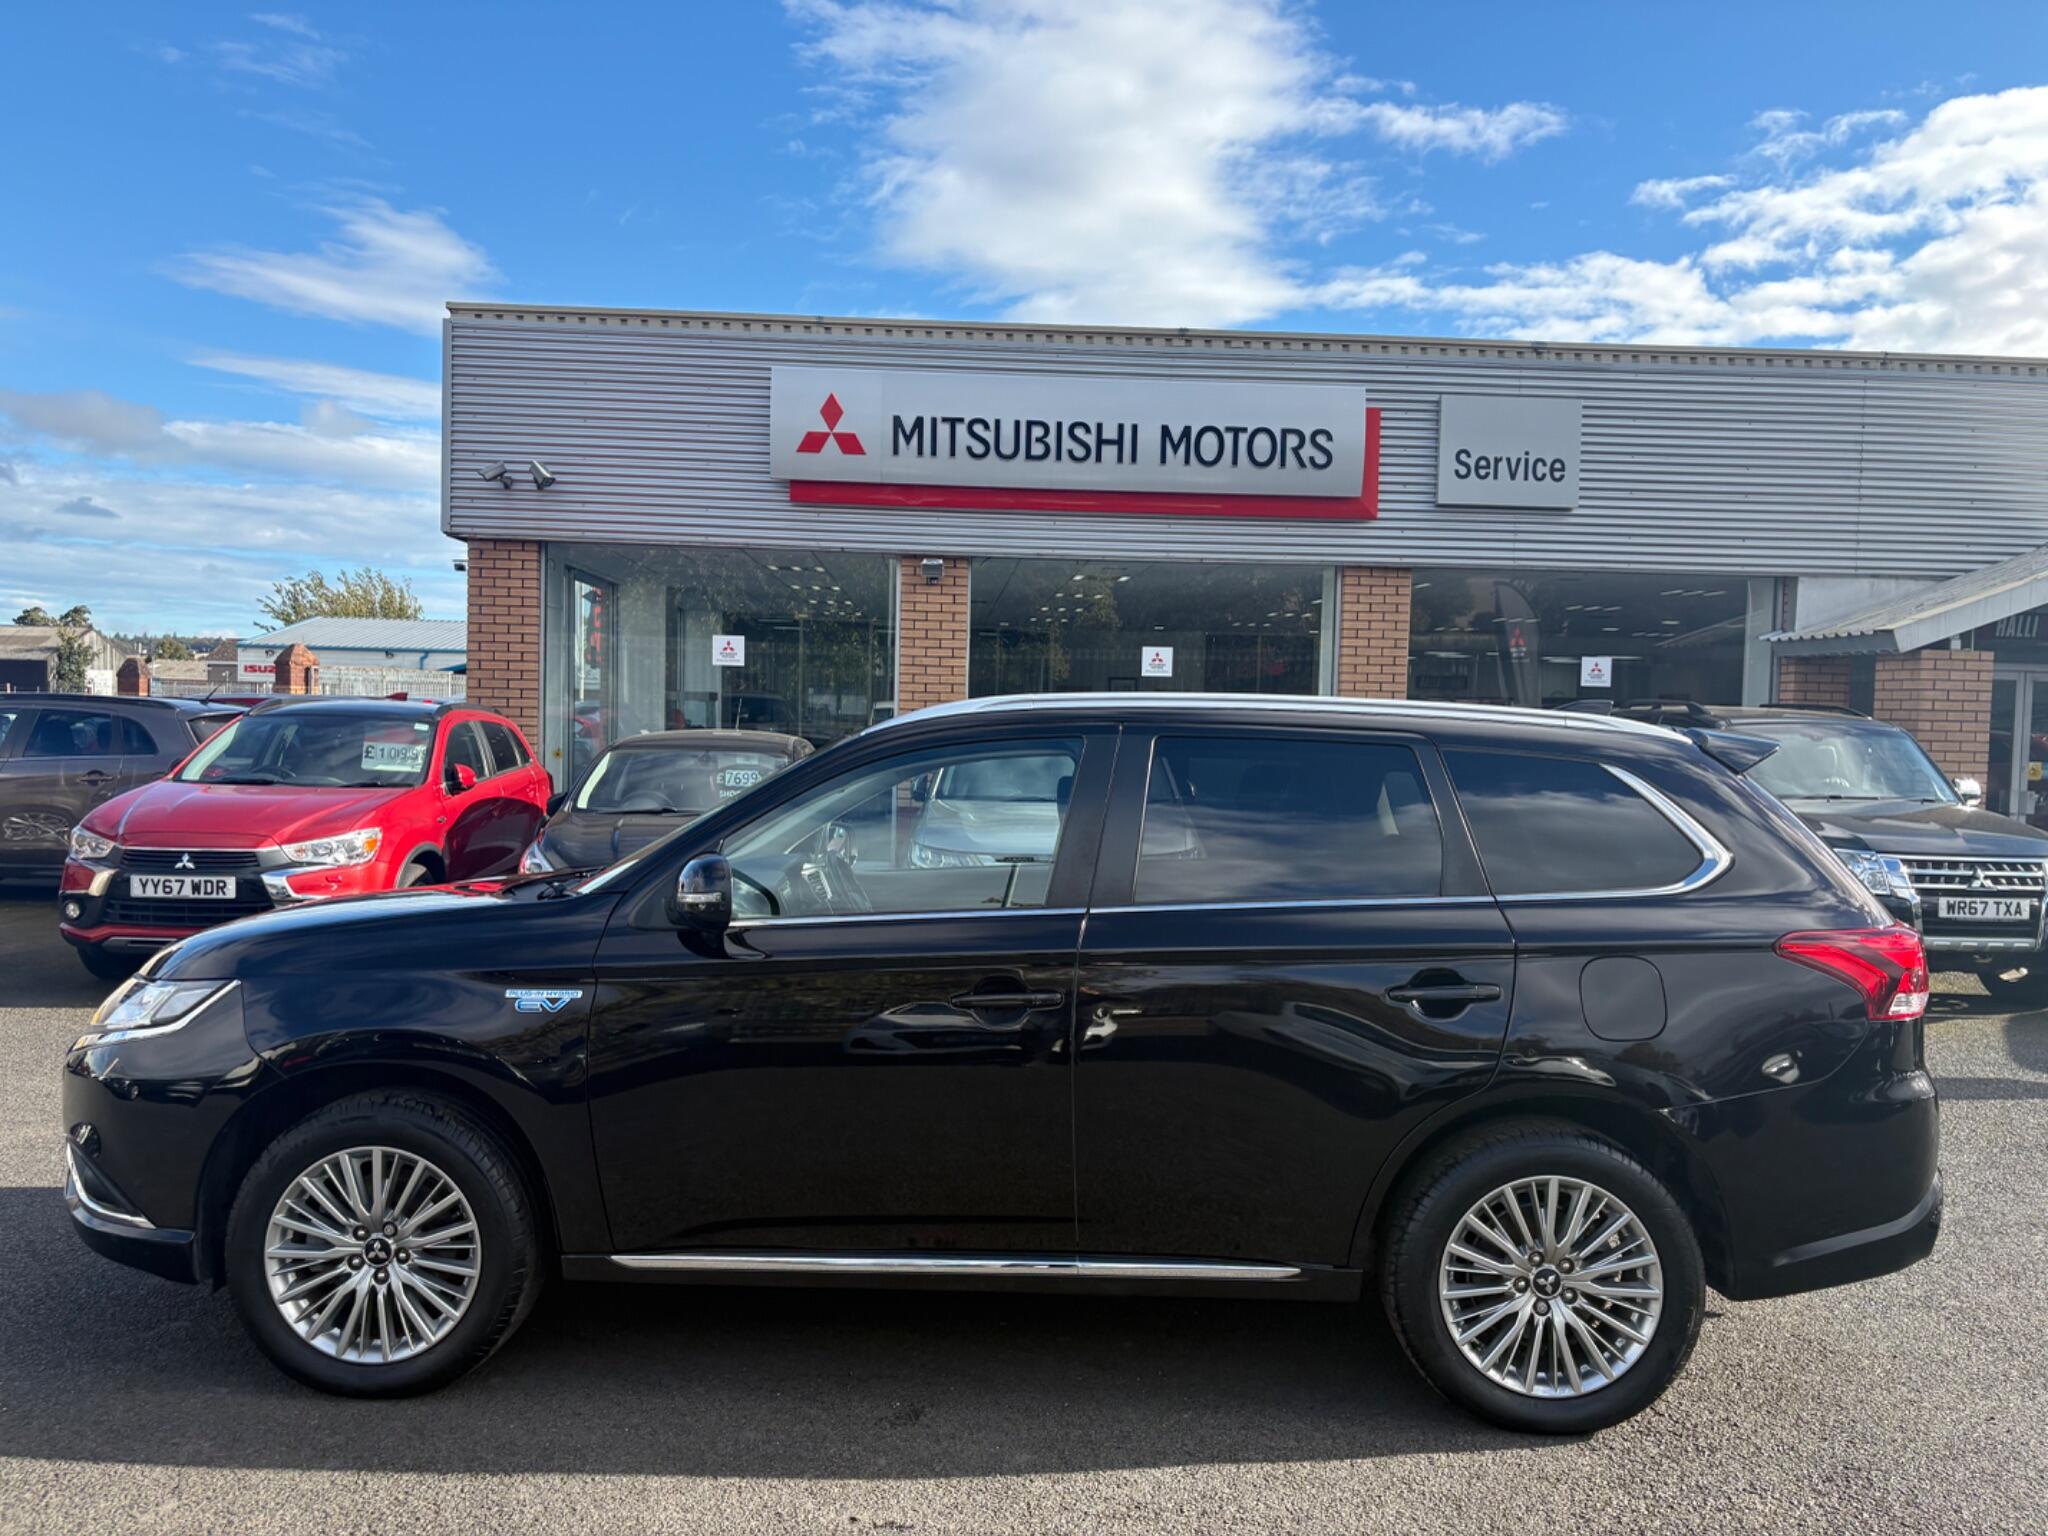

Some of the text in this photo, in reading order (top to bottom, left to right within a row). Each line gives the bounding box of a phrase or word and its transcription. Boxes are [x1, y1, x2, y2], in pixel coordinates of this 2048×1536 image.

[891, 415, 1334, 470] MITSUBISHI MOTORS
[1454, 448, 1566, 482] Service
[139, 878, 227, 896] YY67 WDR
[1946, 900, 2022, 917] WR67 TXA
[515, 998, 571, 1012] EV
